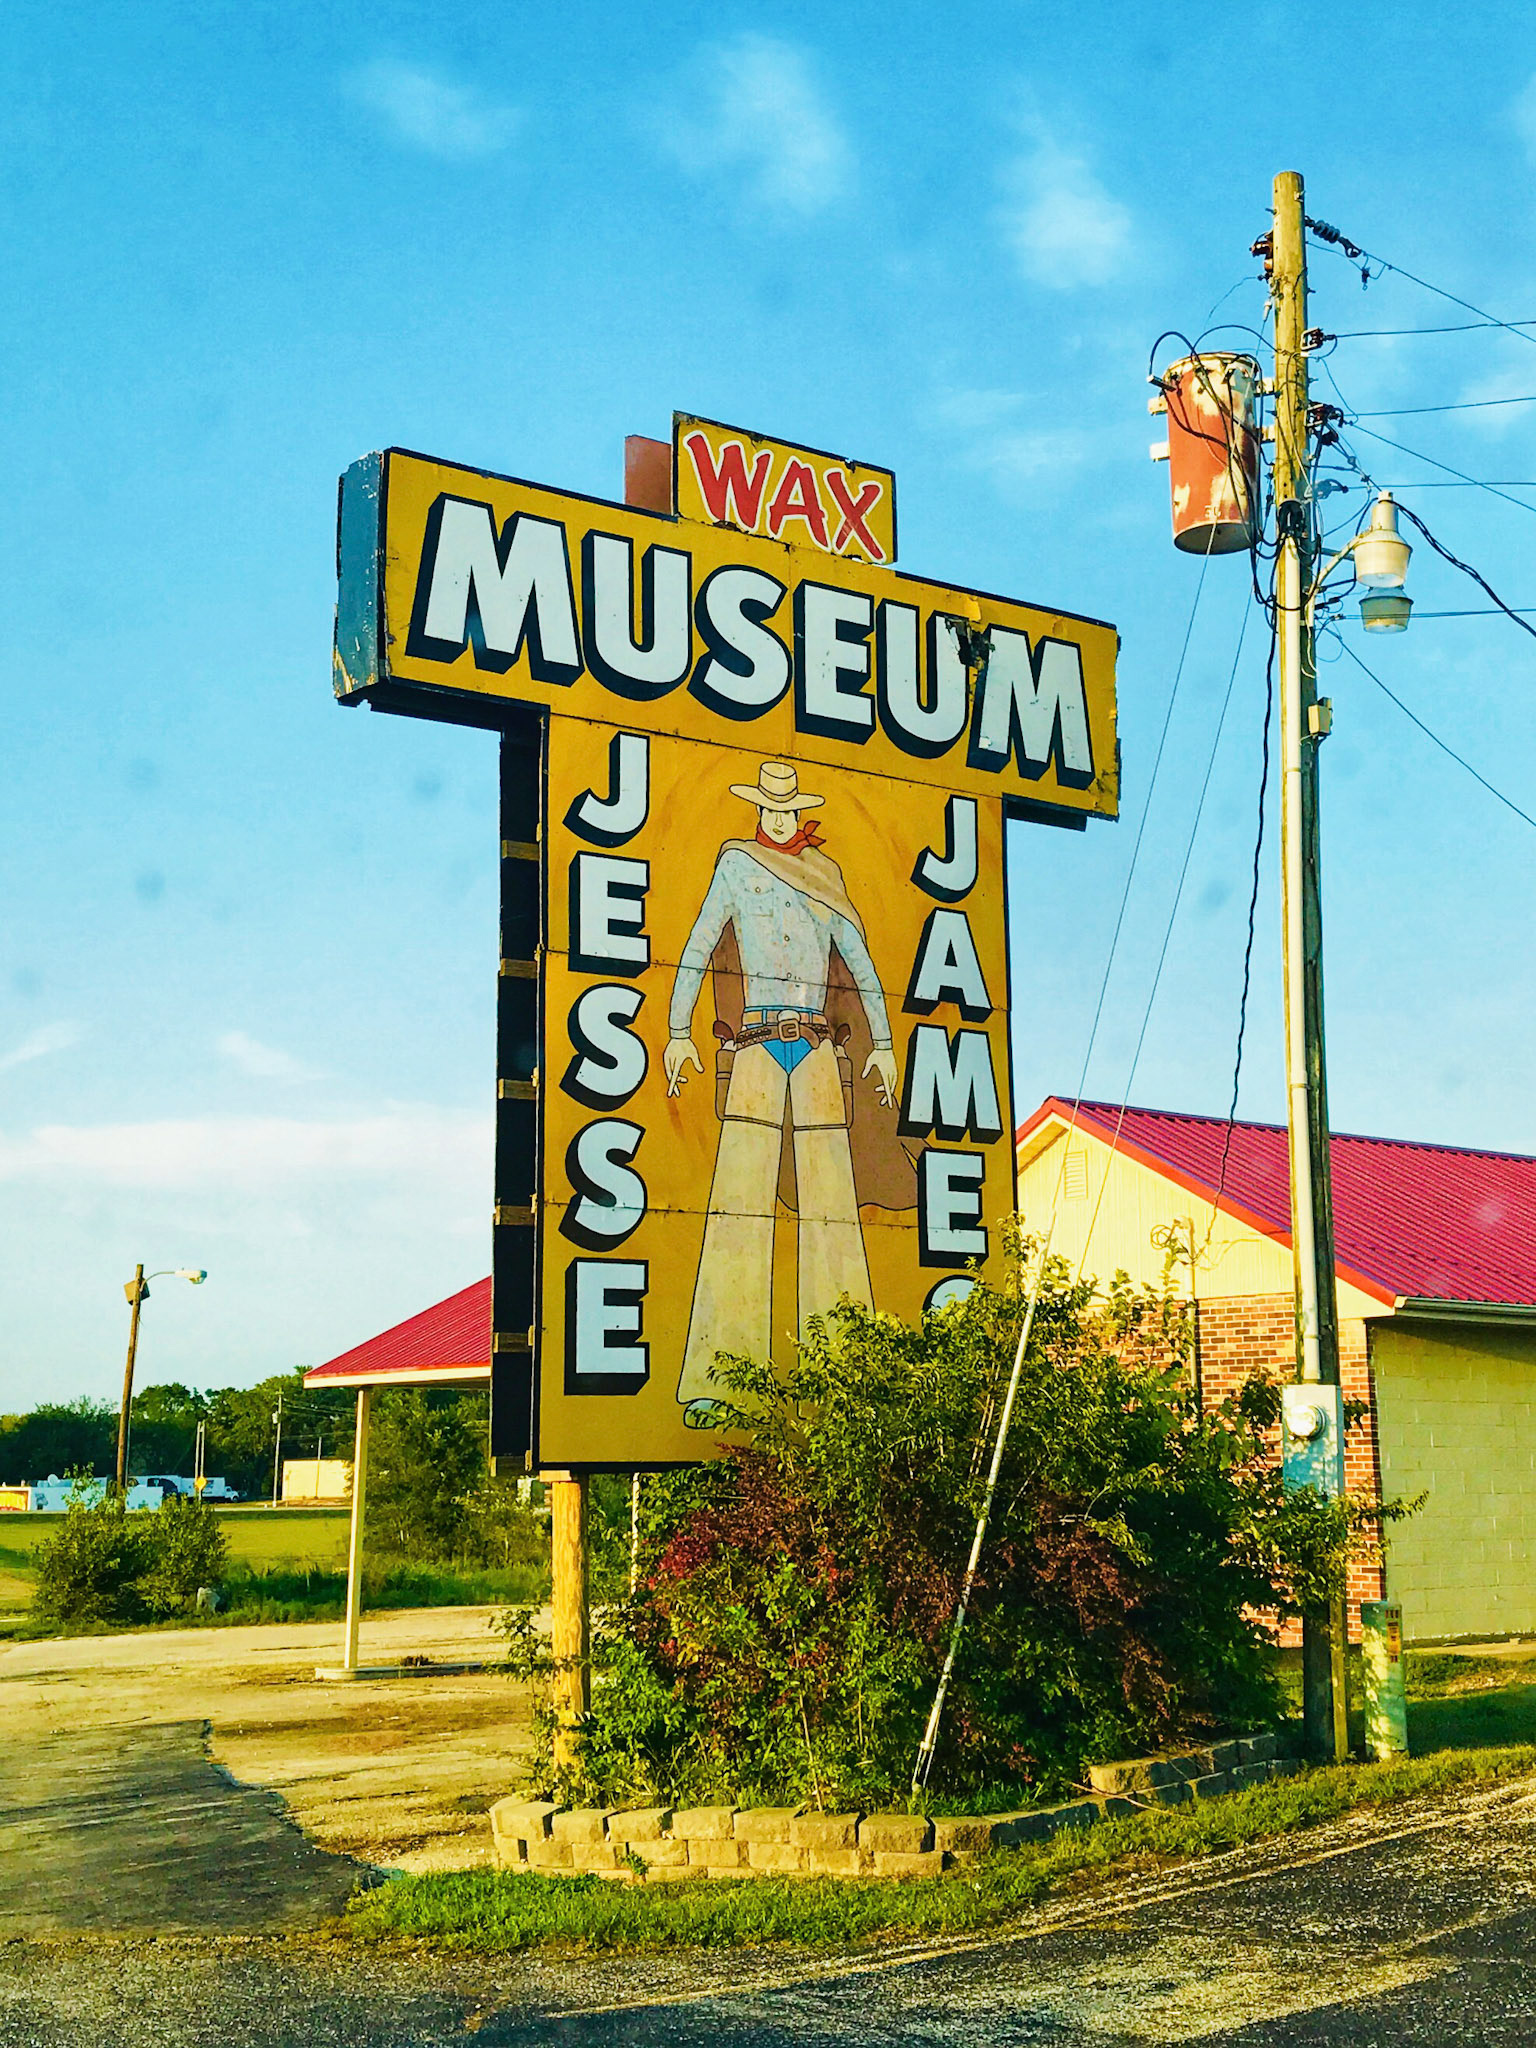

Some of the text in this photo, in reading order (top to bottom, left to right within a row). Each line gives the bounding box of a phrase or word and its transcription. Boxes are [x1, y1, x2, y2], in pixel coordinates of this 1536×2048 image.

[406, 493, 1097, 791] MUSEUM
[684, 429, 888, 562] WAX
[560, 731, 651, 1396] JESSE
